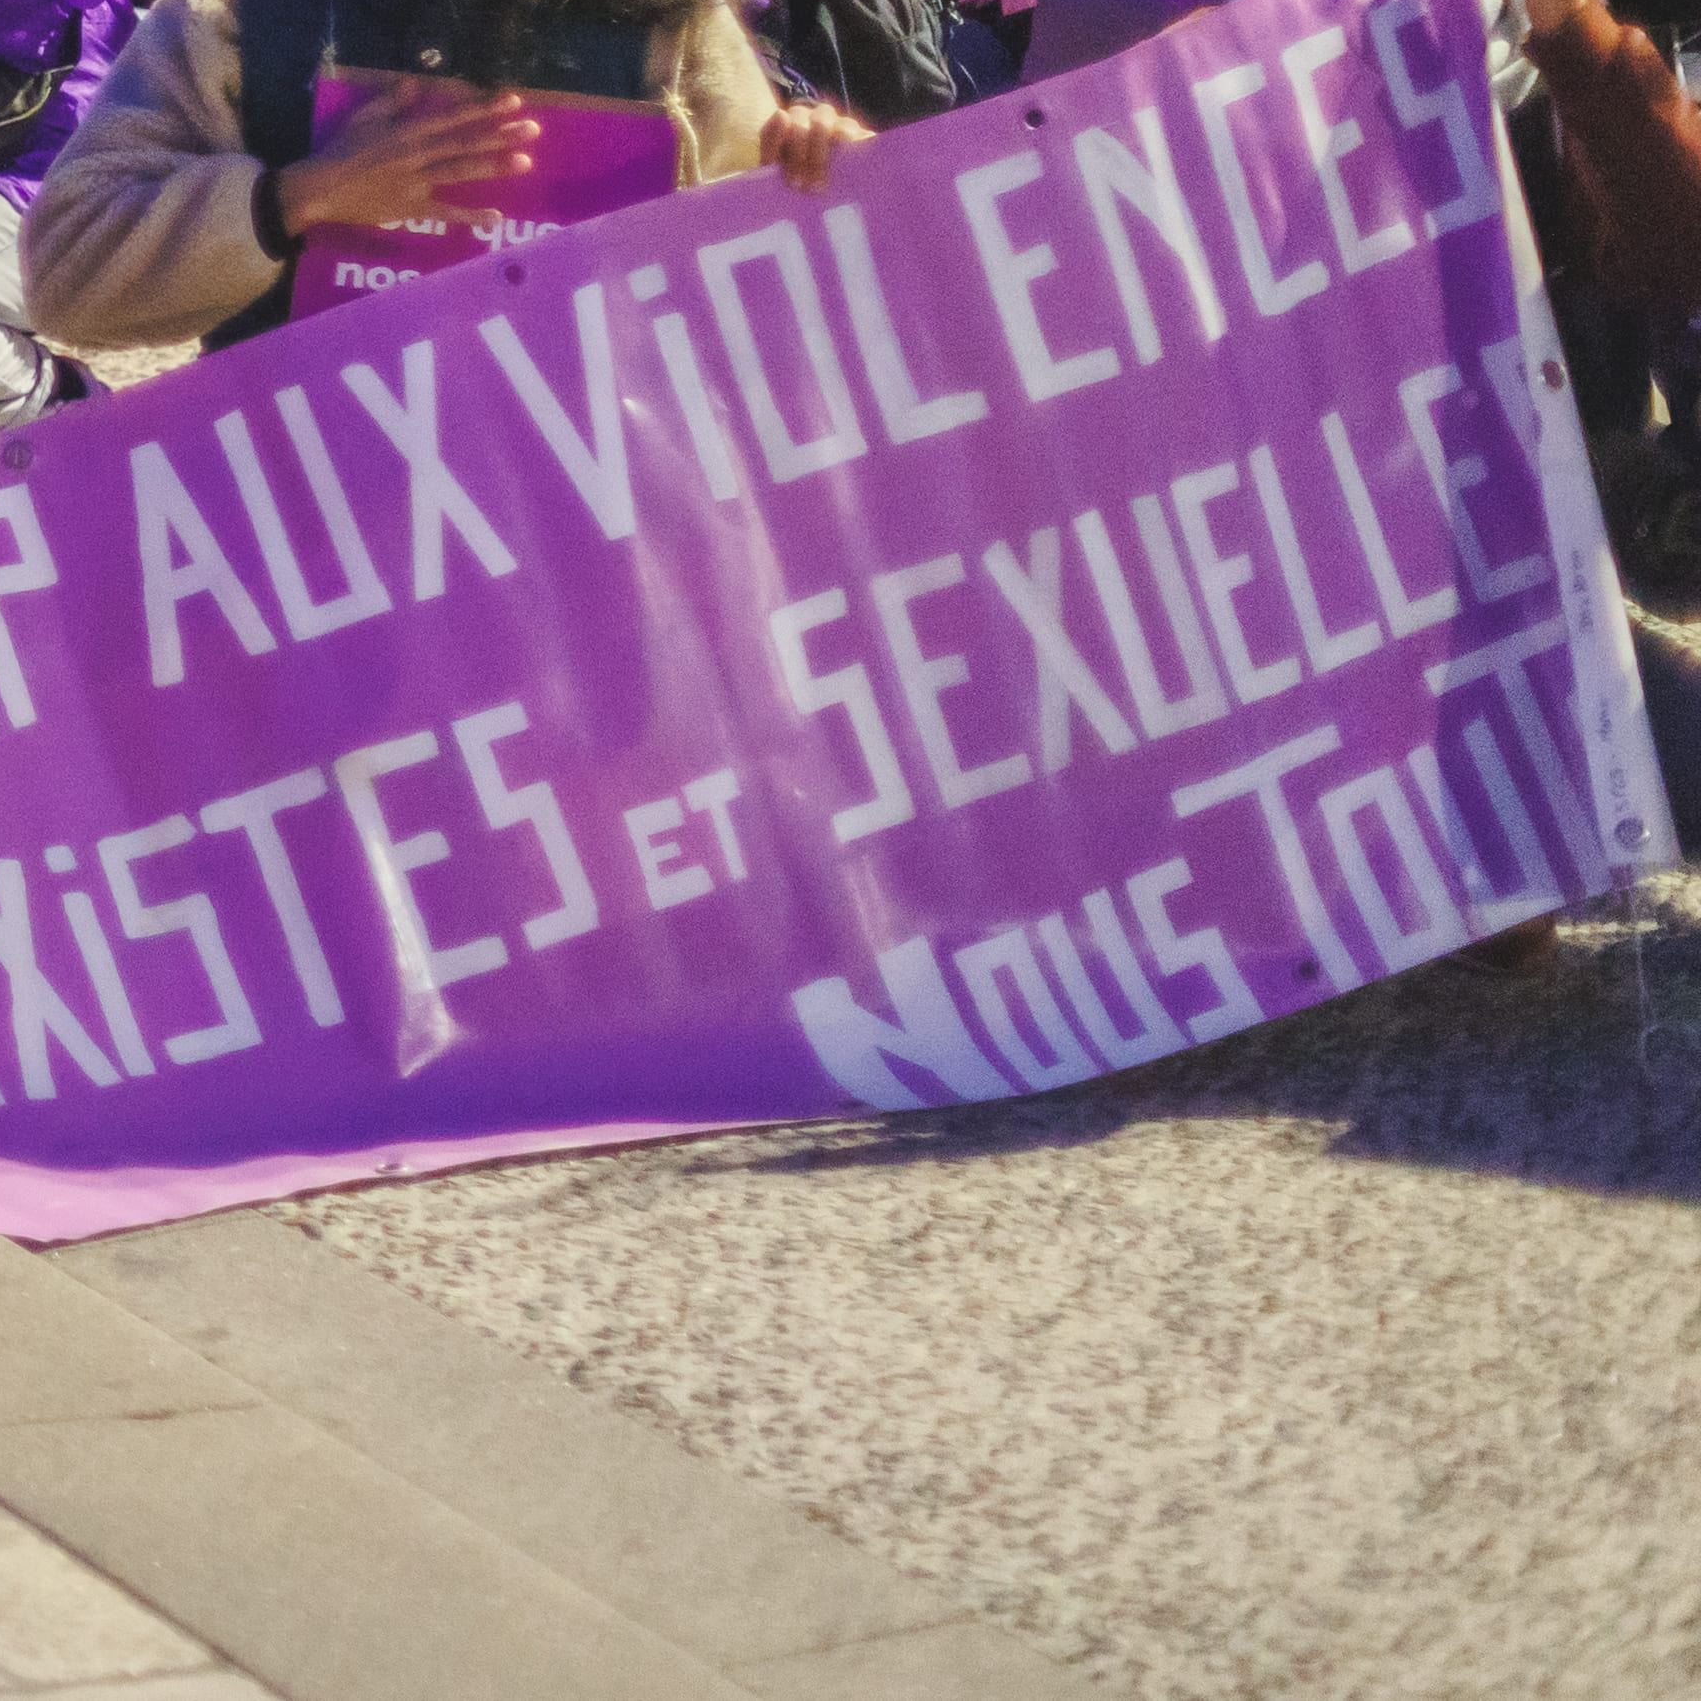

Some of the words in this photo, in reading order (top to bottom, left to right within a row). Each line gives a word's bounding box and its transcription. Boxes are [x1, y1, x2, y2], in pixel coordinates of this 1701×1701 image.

[129, 339, 519, 689] AUX
[623, 768, 749, 911] ET
[791, 855, 1265, 1113] NOUS
